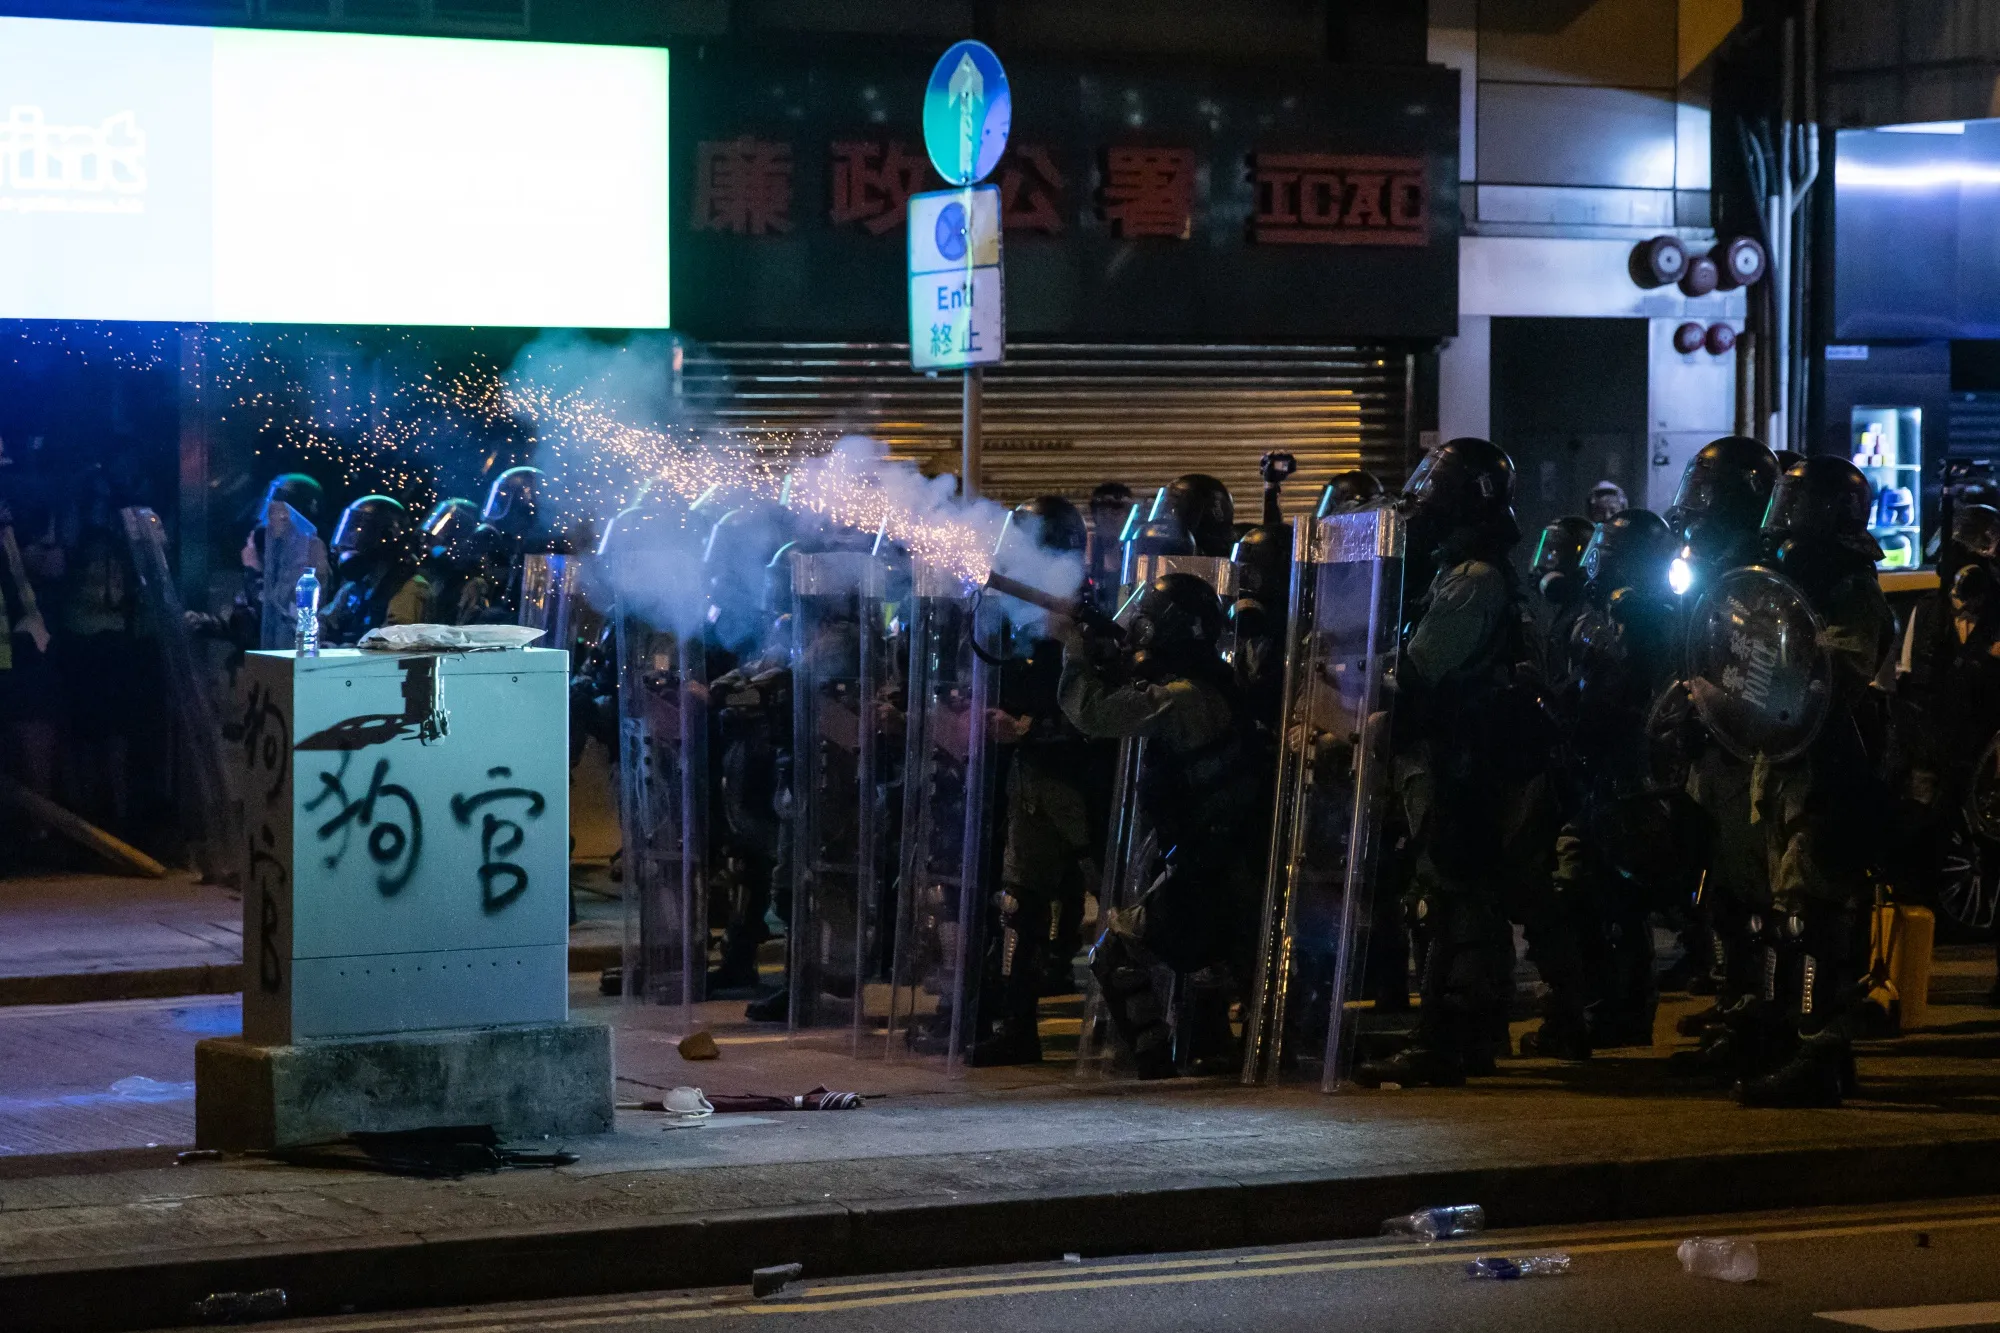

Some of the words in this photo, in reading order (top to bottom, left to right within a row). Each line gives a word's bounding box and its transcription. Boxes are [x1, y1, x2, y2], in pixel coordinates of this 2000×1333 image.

[1256, 171, 1429, 226] ICAC
[937, 283, 974, 310] End
[930, 320, 983, 357] 終止
[303, 748, 545, 915] 狗官
